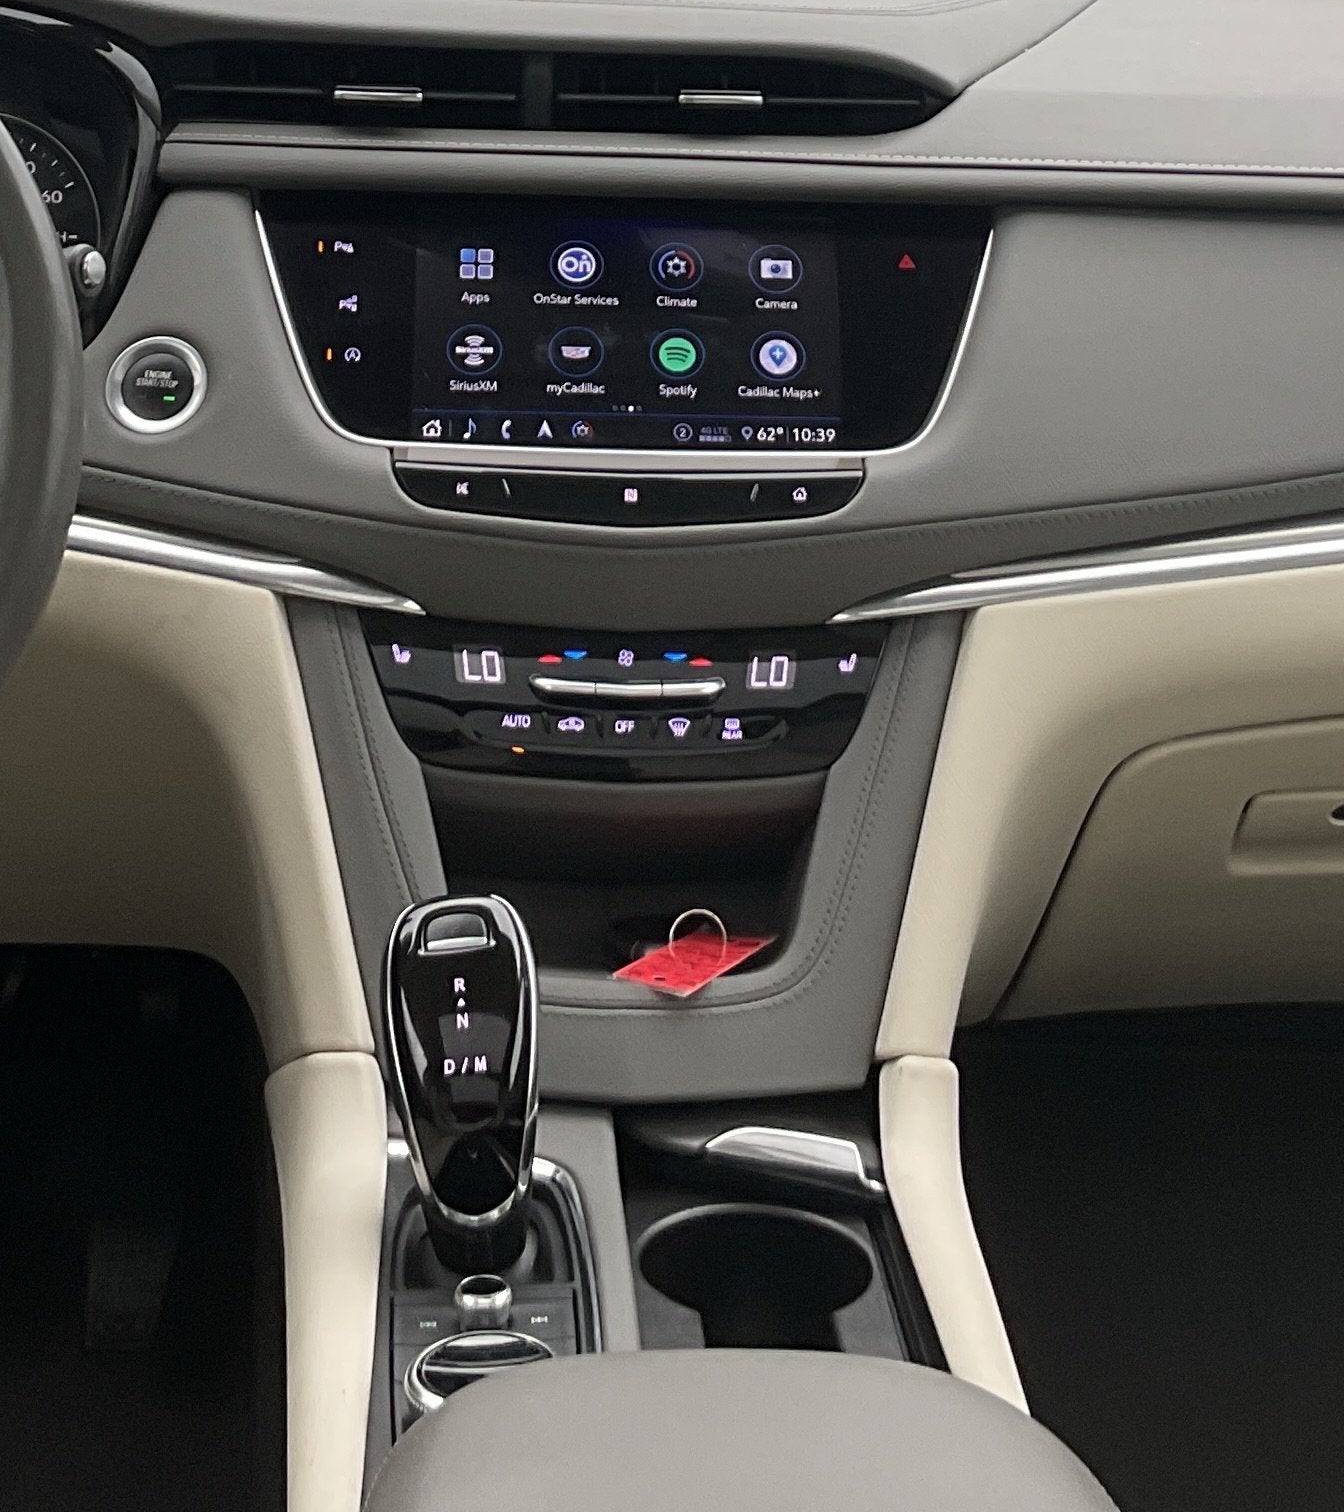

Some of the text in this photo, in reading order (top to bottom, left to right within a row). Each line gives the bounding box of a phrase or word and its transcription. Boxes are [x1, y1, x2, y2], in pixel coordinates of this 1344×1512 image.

[461, 291, 490, 305] Apps
[533, 293, 620, 307] OnStar Services
[656, 295, 698, 308] Climate
[755, 297, 798, 310] Camera
[144, 369, 173, 379] ENGINE
[136, 377, 179, 388] START/STOP
[449, 379, 498, 392] SiriusXM
[546, 381, 606, 395] myCadillac
[659, 383, 697, 398] Spotify
[738, 385, 781, 399] Cadillac
[700, 426, 729, 435] 4G LTE
[756, 426, 784, 442] 62°
[792, 427, 836, 443] 10:39
[461, 650, 502, 683] LO
[751, 654, 790, 688] LO
[501, 713, 531, 730] AUTO
[614, 720, 635, 734] OFF
[721, 729, 743, 740] REAR
[453, 977, 466, 993] R
[456, 1011, 470, 1029] N
